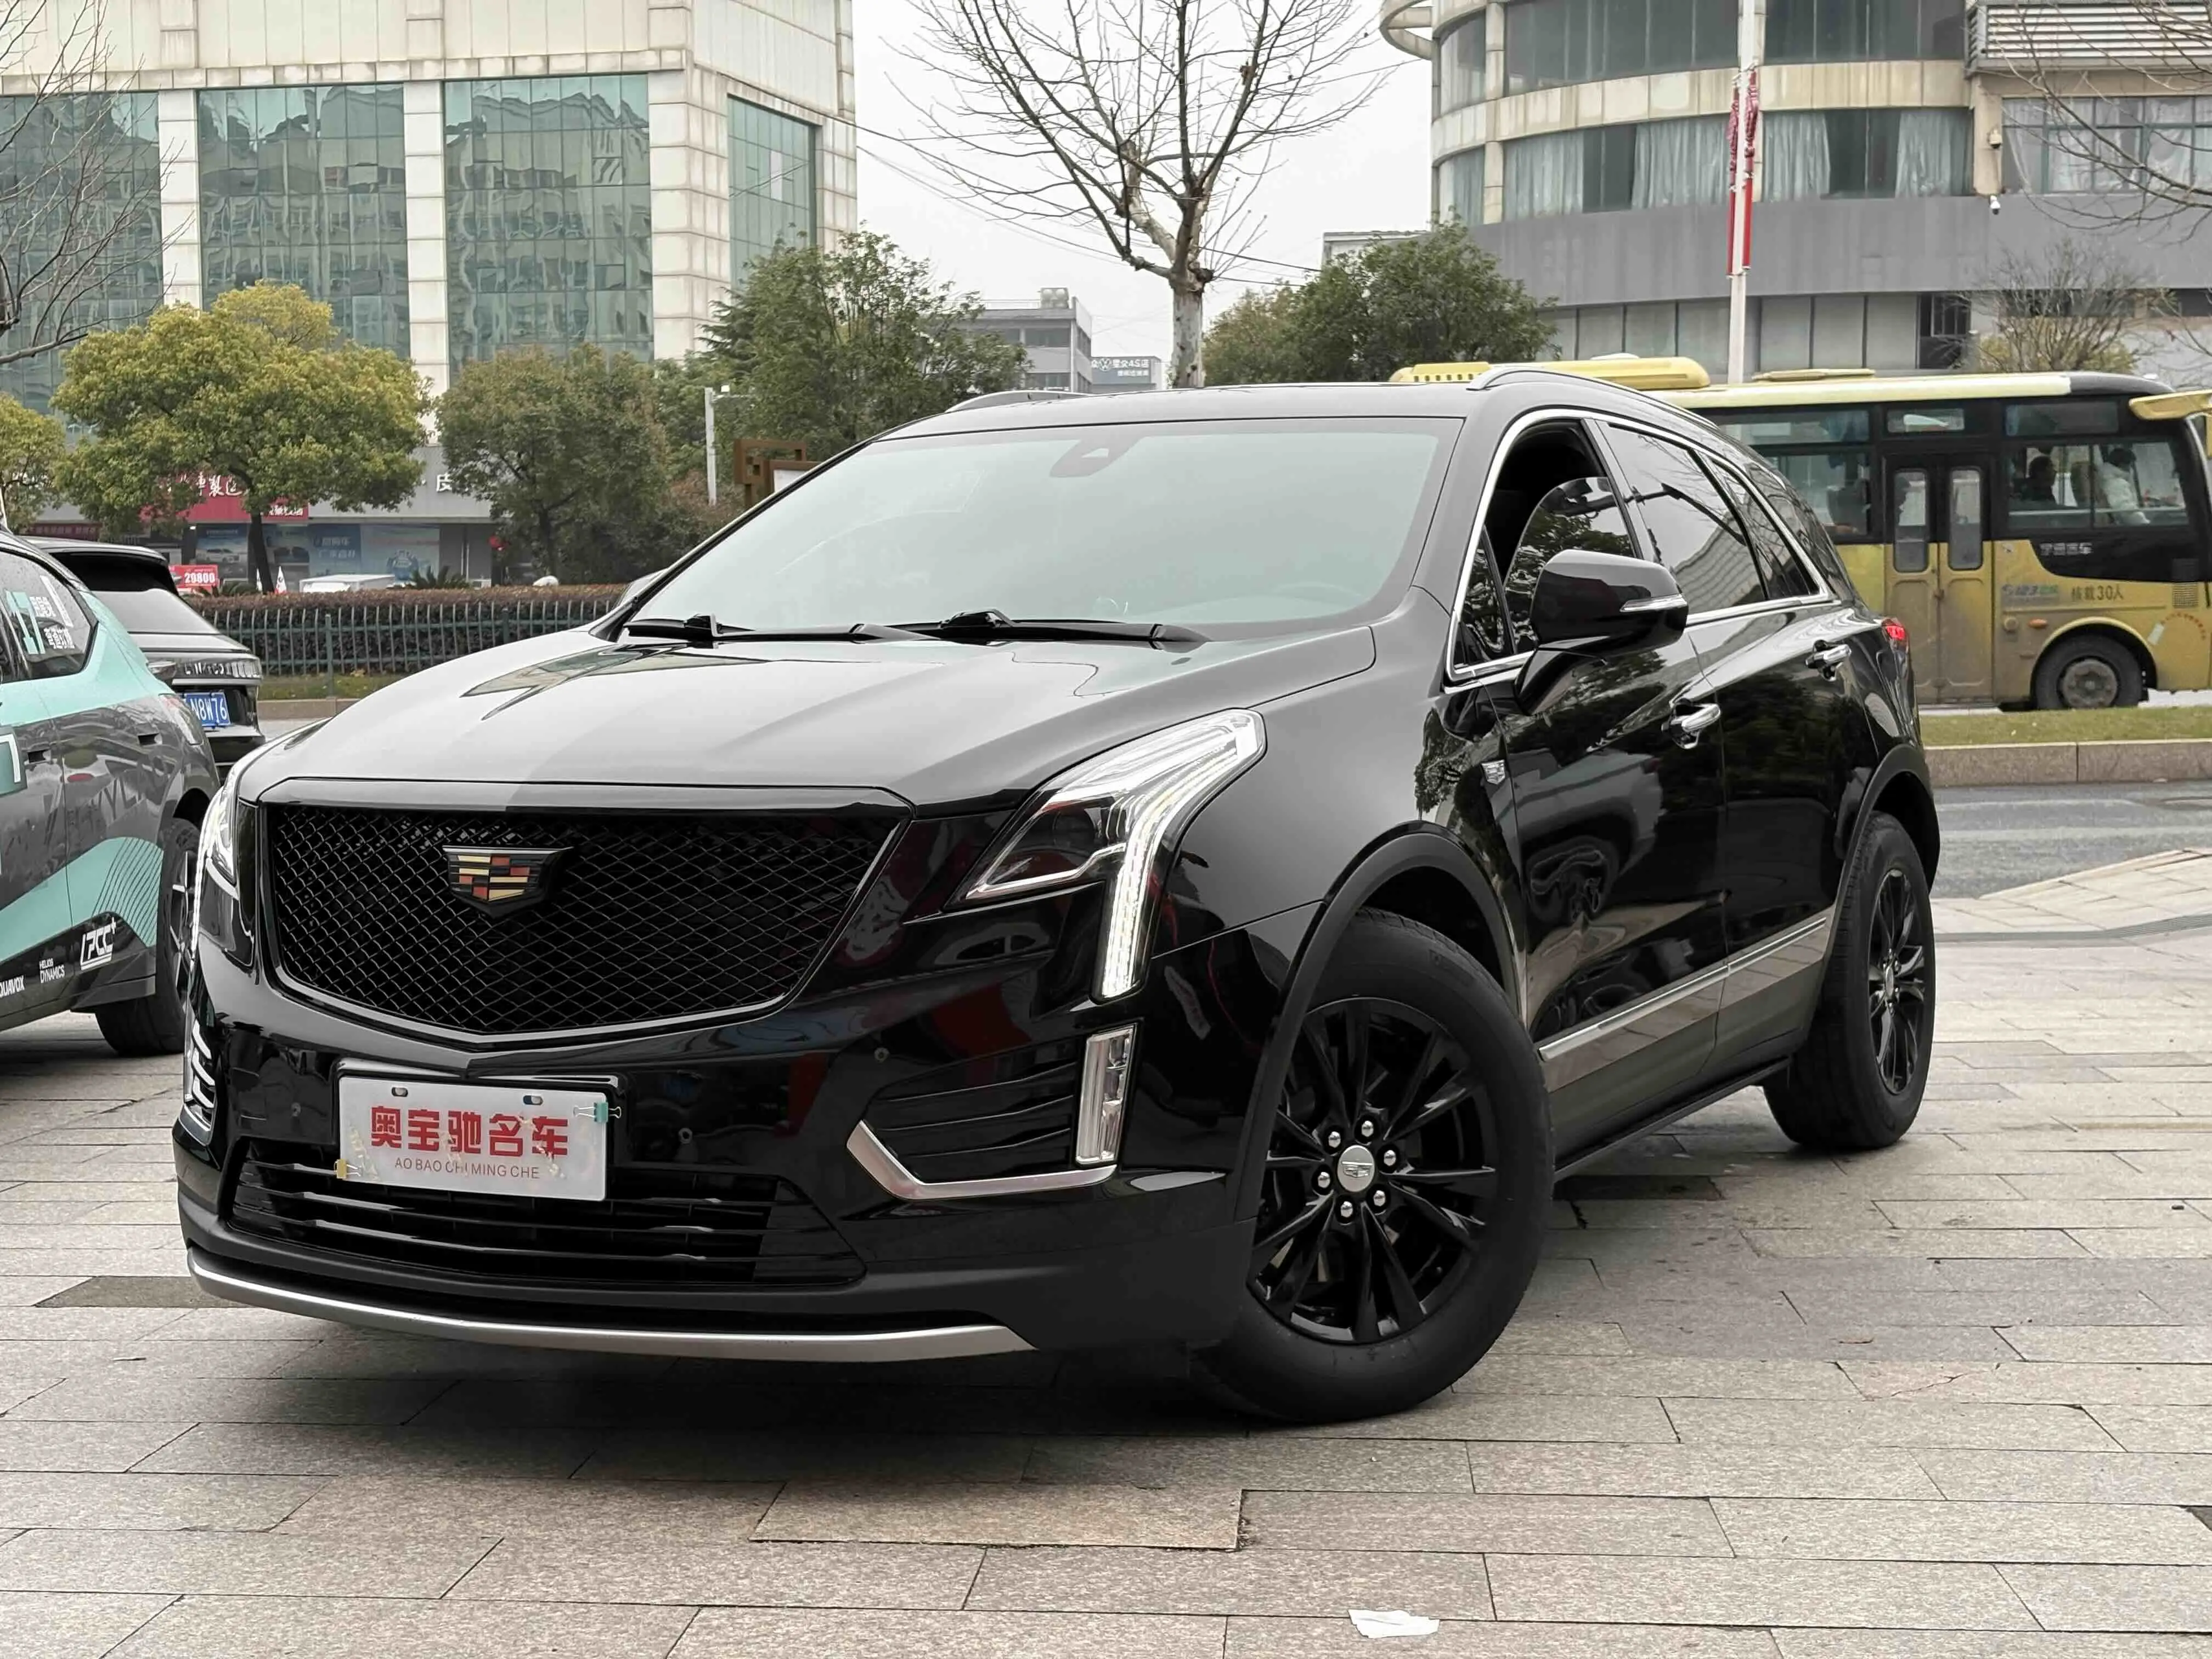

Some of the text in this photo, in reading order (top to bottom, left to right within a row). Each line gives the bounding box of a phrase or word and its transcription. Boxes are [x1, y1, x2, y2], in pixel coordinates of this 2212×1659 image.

[183, 698, 227, 723] N8W76
[40, 965, 65, 983] DYNAMICS
[371, 1106, 568, 1158] 奥宝驰名车
[395, 1158, 413, 1170] AO
[415, 1159, 443, 1172] BAO
[471, 1164, 507, 1178] MING
[510, 1166, 540, 1179] CHE
